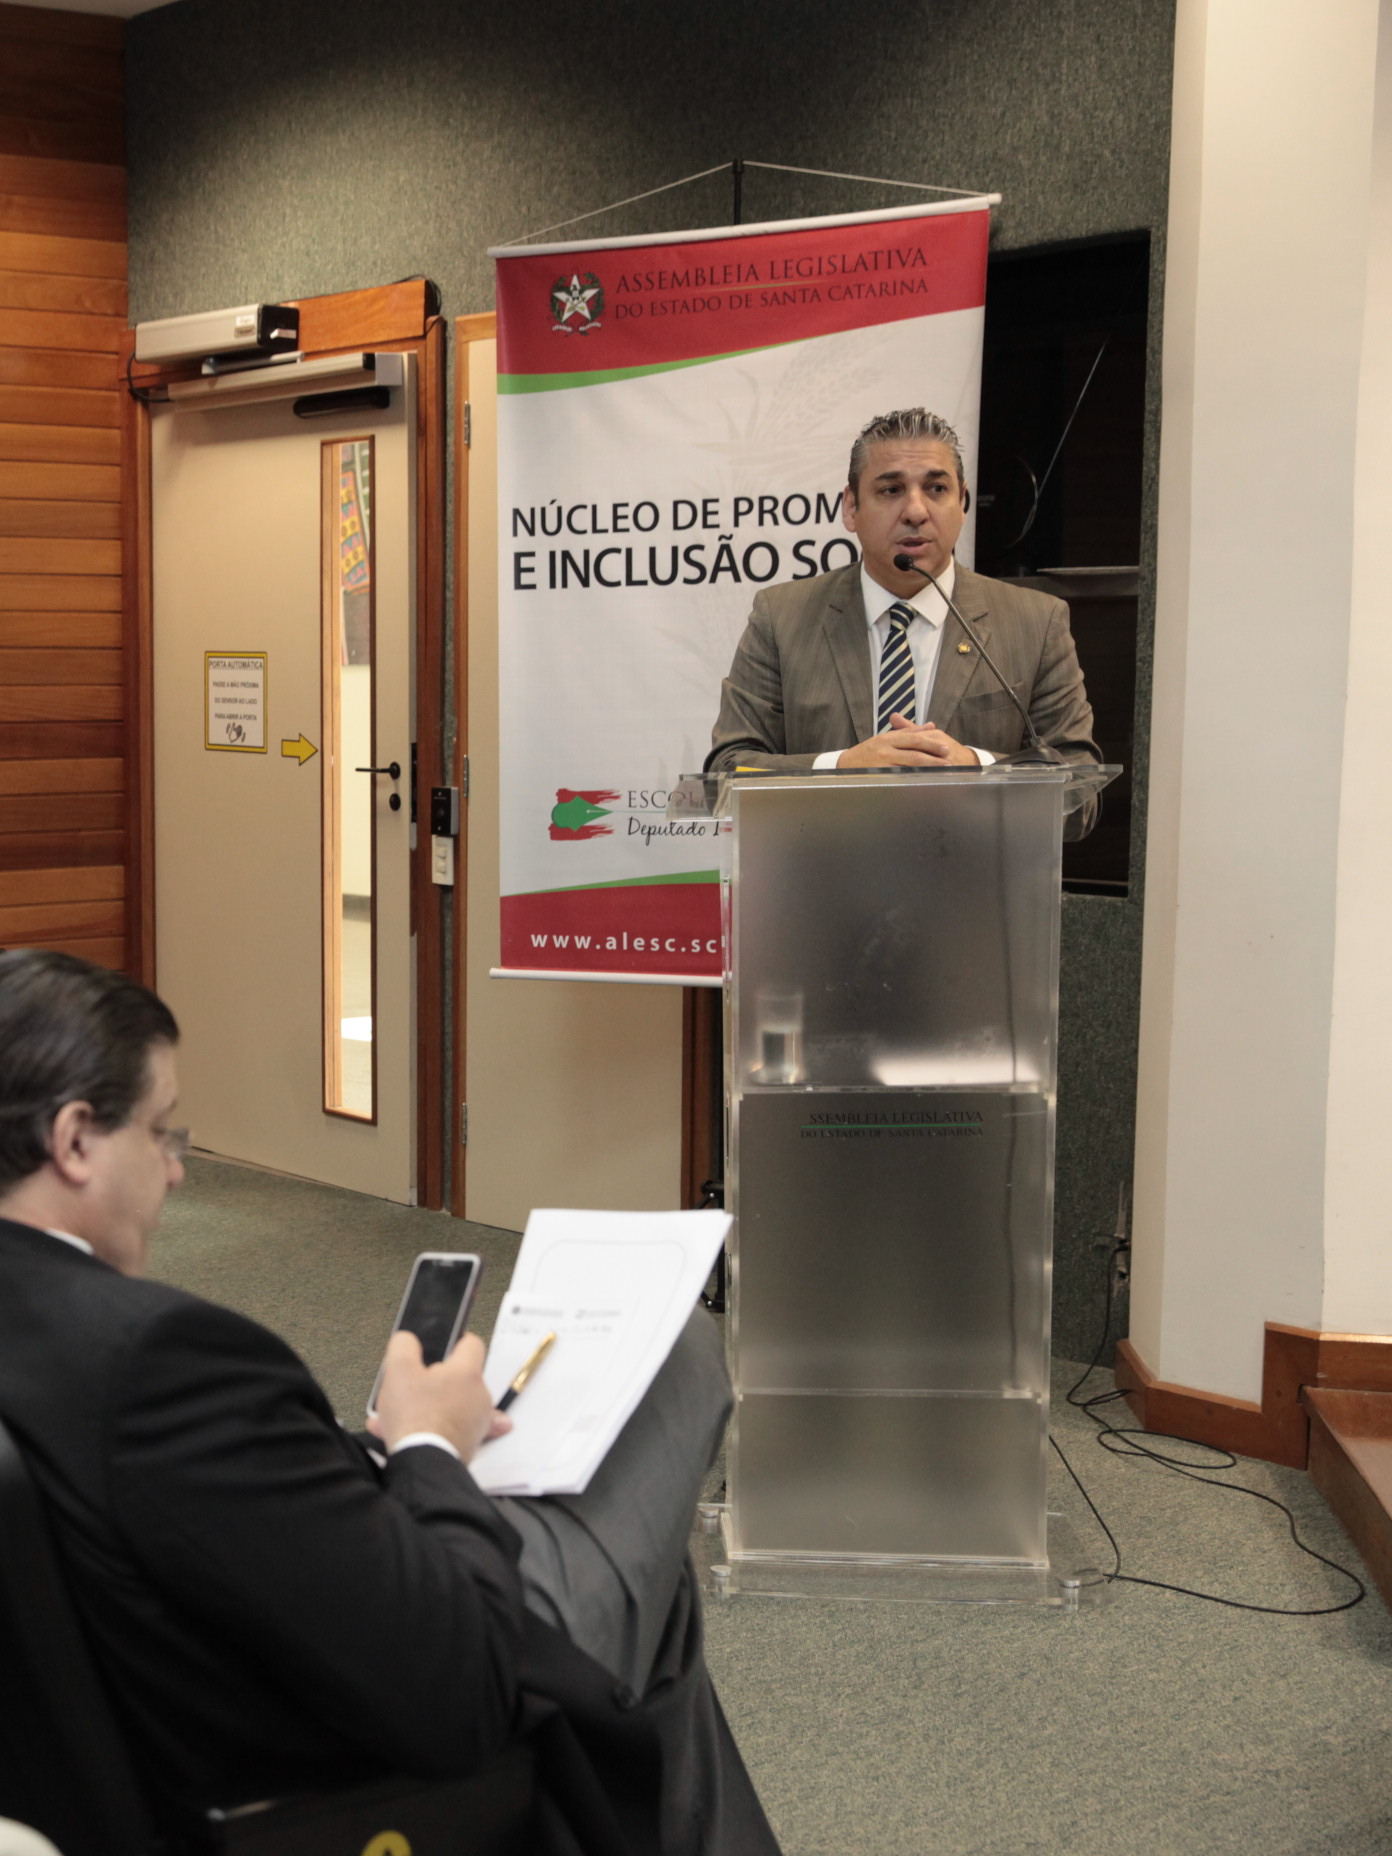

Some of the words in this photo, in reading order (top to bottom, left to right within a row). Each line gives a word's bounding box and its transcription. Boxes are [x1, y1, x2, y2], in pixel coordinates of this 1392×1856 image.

[615, 263, 760, 294] ASSEMBLEIA
[769, 248, 928, 281] LEGISLATIVA
[614, 303, 644, 320] DO
[650, 296, 722, 318] ESTADO
[729, 293, 753, 311] DE
[759, 287, 822, 308] SANTA
[827, 278, 929, 302] CATARINA
[512, 499, 660, 538] NÚCLEO
[672, 498, 720, 531] DE
[733, 493, 845, 528] PROM
[514, 551, 537, 590] E
[549, 533, 780, 590] INCLUSÃO
[792, 538, 859, 581] SO
[627, 816, 707, 847] Deputado
[530, 931, 719, 954] www.alesc.sc
[892, 1110, 984, 1124] LEGISLATIVA
